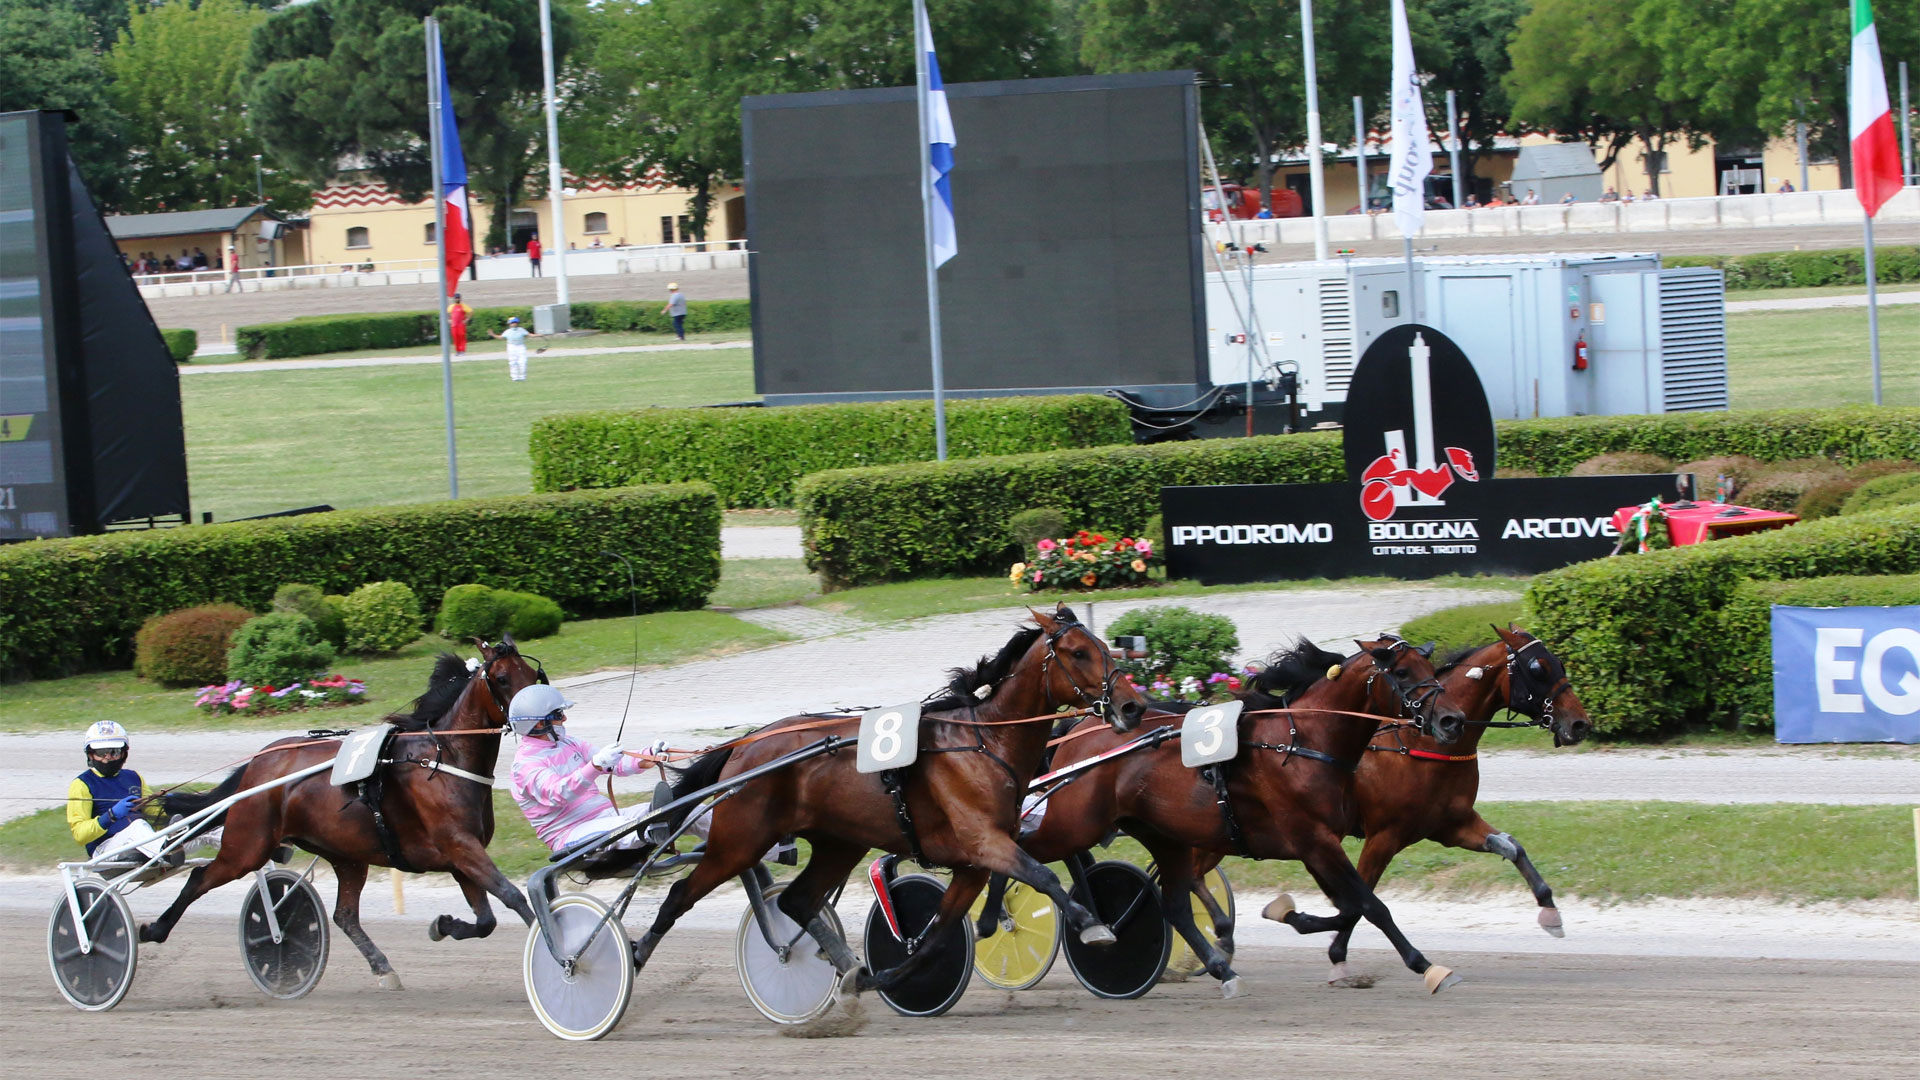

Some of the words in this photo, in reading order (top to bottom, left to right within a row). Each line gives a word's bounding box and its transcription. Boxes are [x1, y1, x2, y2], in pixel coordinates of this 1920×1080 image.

[1171, 523, 1333, 546] IPPODROMO
[1368, 521, 1479, 540] BOLOGNA
[1405, 545, 1431, 555] DEL
[1430, 544, 1477, 554] TROTTO
[1815, 627, 1920, 716] EQ
[344, 729, 379, 776] 7
[870, 711, 903, 762] 8
[1193, 709, 1224, 756] 3
